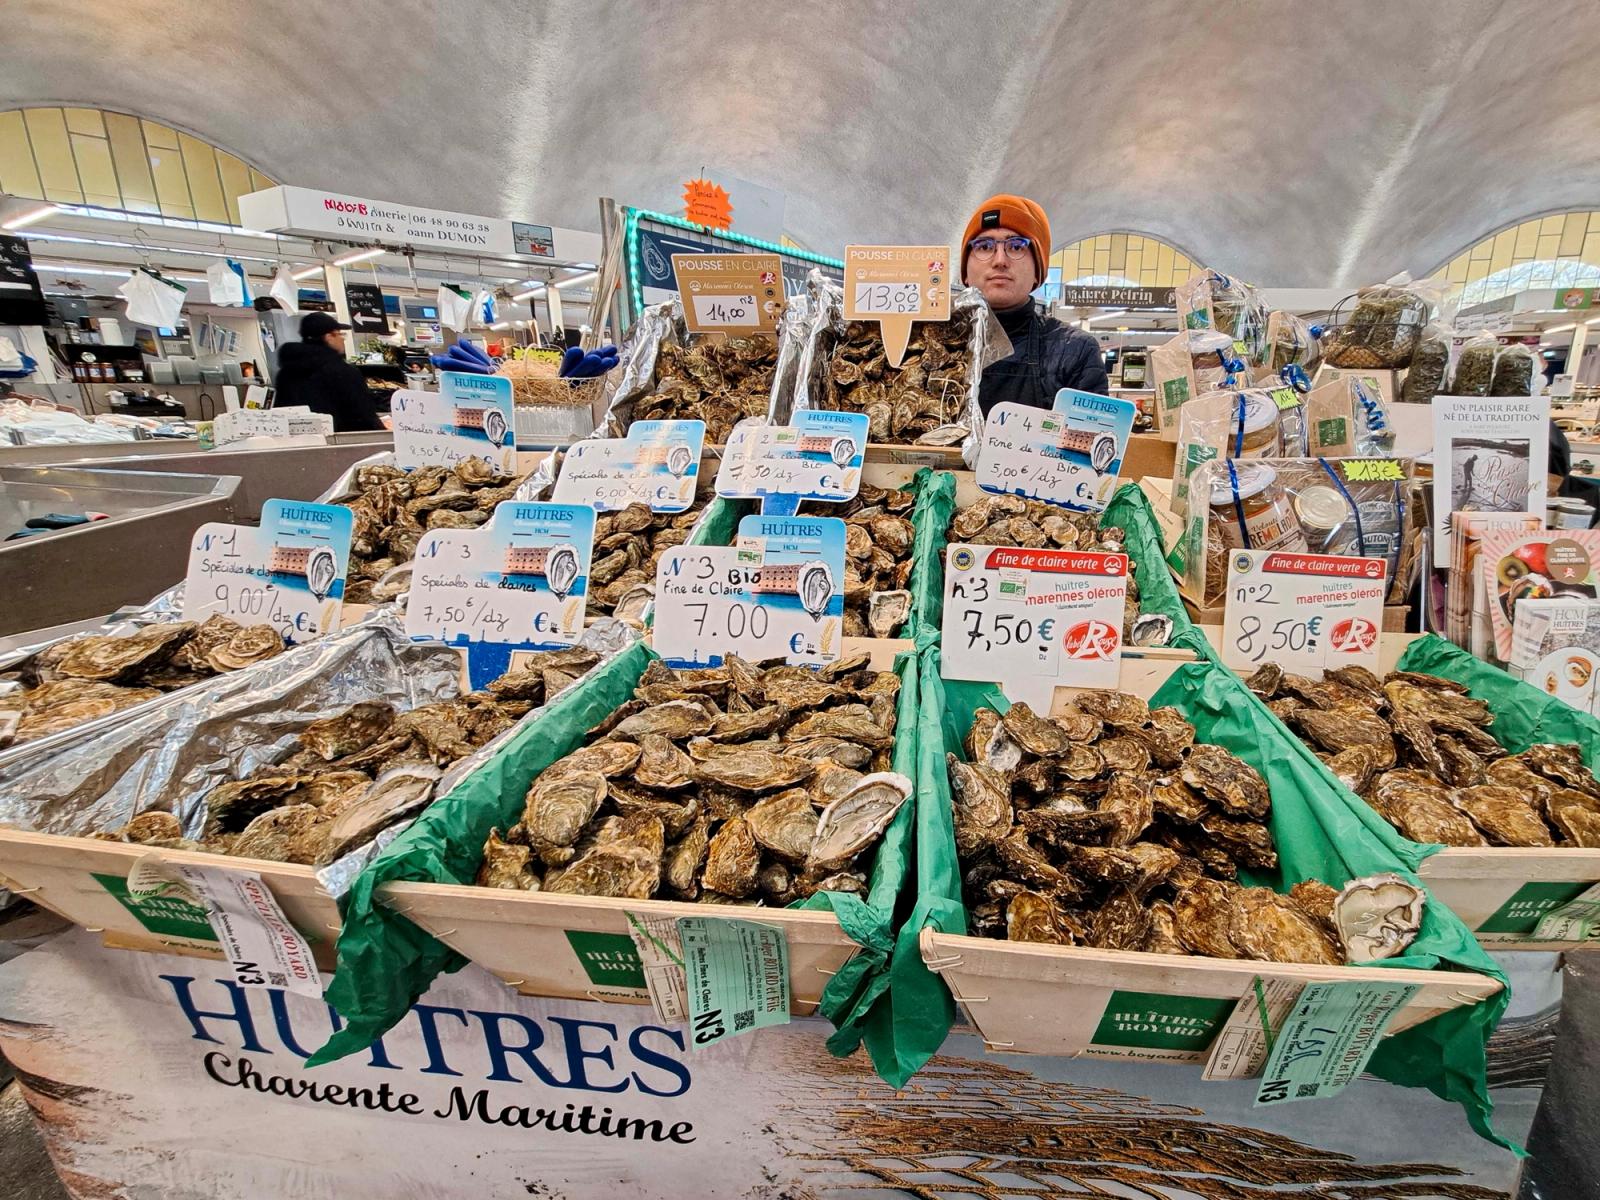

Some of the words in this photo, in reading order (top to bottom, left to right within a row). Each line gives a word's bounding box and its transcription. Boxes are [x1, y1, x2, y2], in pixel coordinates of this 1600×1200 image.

[437, 230, 487, 245] DUMON
[850, 250, 893, 260] POUSSE
[896, 251, 910, 260] EN
[912, 251, 945, 260] CLAIRE
[678, 260, 724, 271] POUSSE
[726, 261, 740, 271] EN
[743, 260, 778, 271] CLAIRE
[856, 285, 919, 311] 13,00
[706, 304, 745, 322] 14,00
[455, 377, 497, 390] HUÎTRES
[420, 402, 425, 415] 2
[1072, 396, 1120, 414] HUÎTRES
[1452, 403, 1465, 412] UN
[1469, 404, 1503, 412] PLAISIR
[1506, 404, 1530, 412] RARE
[807, 411, 853, 423] HUÎTRES
[1023, 416, 1032, 432] 4
[1444, 413, 1456, 421] NÉ
[1458, 413, 1470, 421] DE
[1472, 413, 1482, 421] LA
[1485, 413, 1540, 422] TRADITION
[760, 435, 769, 444] 2
[988, 436, 1012, 450] Fine
[1020, 443, 1032, 453] de
[604, 448, 611, 457] 4
[820, 475, 832, 488] €
[656, 486, 668, 500] €
[280, 507, 333, 523] HUÎTRES
[515, 506, 574, 521] HUÎTRES
[761, 520, 823, 536] HUÎTRES
[460, 544, 471, 559] 3
[696, 556, 715, 579] 3
[995, 552, 1018, 565] Fine
[1021, 553, 1035, 566] de
[1037, 554, 1068, 568] claire
[1071, 557, 1099, 570] verte
[1271, 557, 1291, 568] Fine
[1293, 558, 1305, 569] de
[1308, 559, 1335, 572] claire
[1337, 562, 1361, 573] verte
[245, 564, 255, 576] de
[475, 580, 490, 589] de
[664, 579, 686, 595] Fine
[692, 583, 704, 593] de
[709, 582, 744, 596] Claire
[1025, 592, 1084, 606] marennes
[1087, 586, 1124, 600] oléron
[1296, 592, 1348, 605] marennes
[295, 612, 310, 631] €
[534, 612, 549, 633] €
[683, 603, 768, 639] 7.00
[1555, 609, 1584, 620] HCM
[963, 609, 1032, 651] 7,50
[1037, 618, 1055, 642] €
[789, 633, 804, 654] €
[1236, 615, 1306, 662] 8,50
[1307, 616, 1323, 636] €
[281, 934, 308, 980] BOYARD
[763, 958, 779, 985] BOYARD
[702, 989, 712, 1012] Claires
[1113, 1011, 1216, 1029] HUÎTRES
[1111, 1022, 1204, 1037] BOYARD
[1344, 1027, 1374, 1062] BOYARD
[204, 1050, 425, 1116] Charente
[433, 1086, 697, 1145] Maritime
